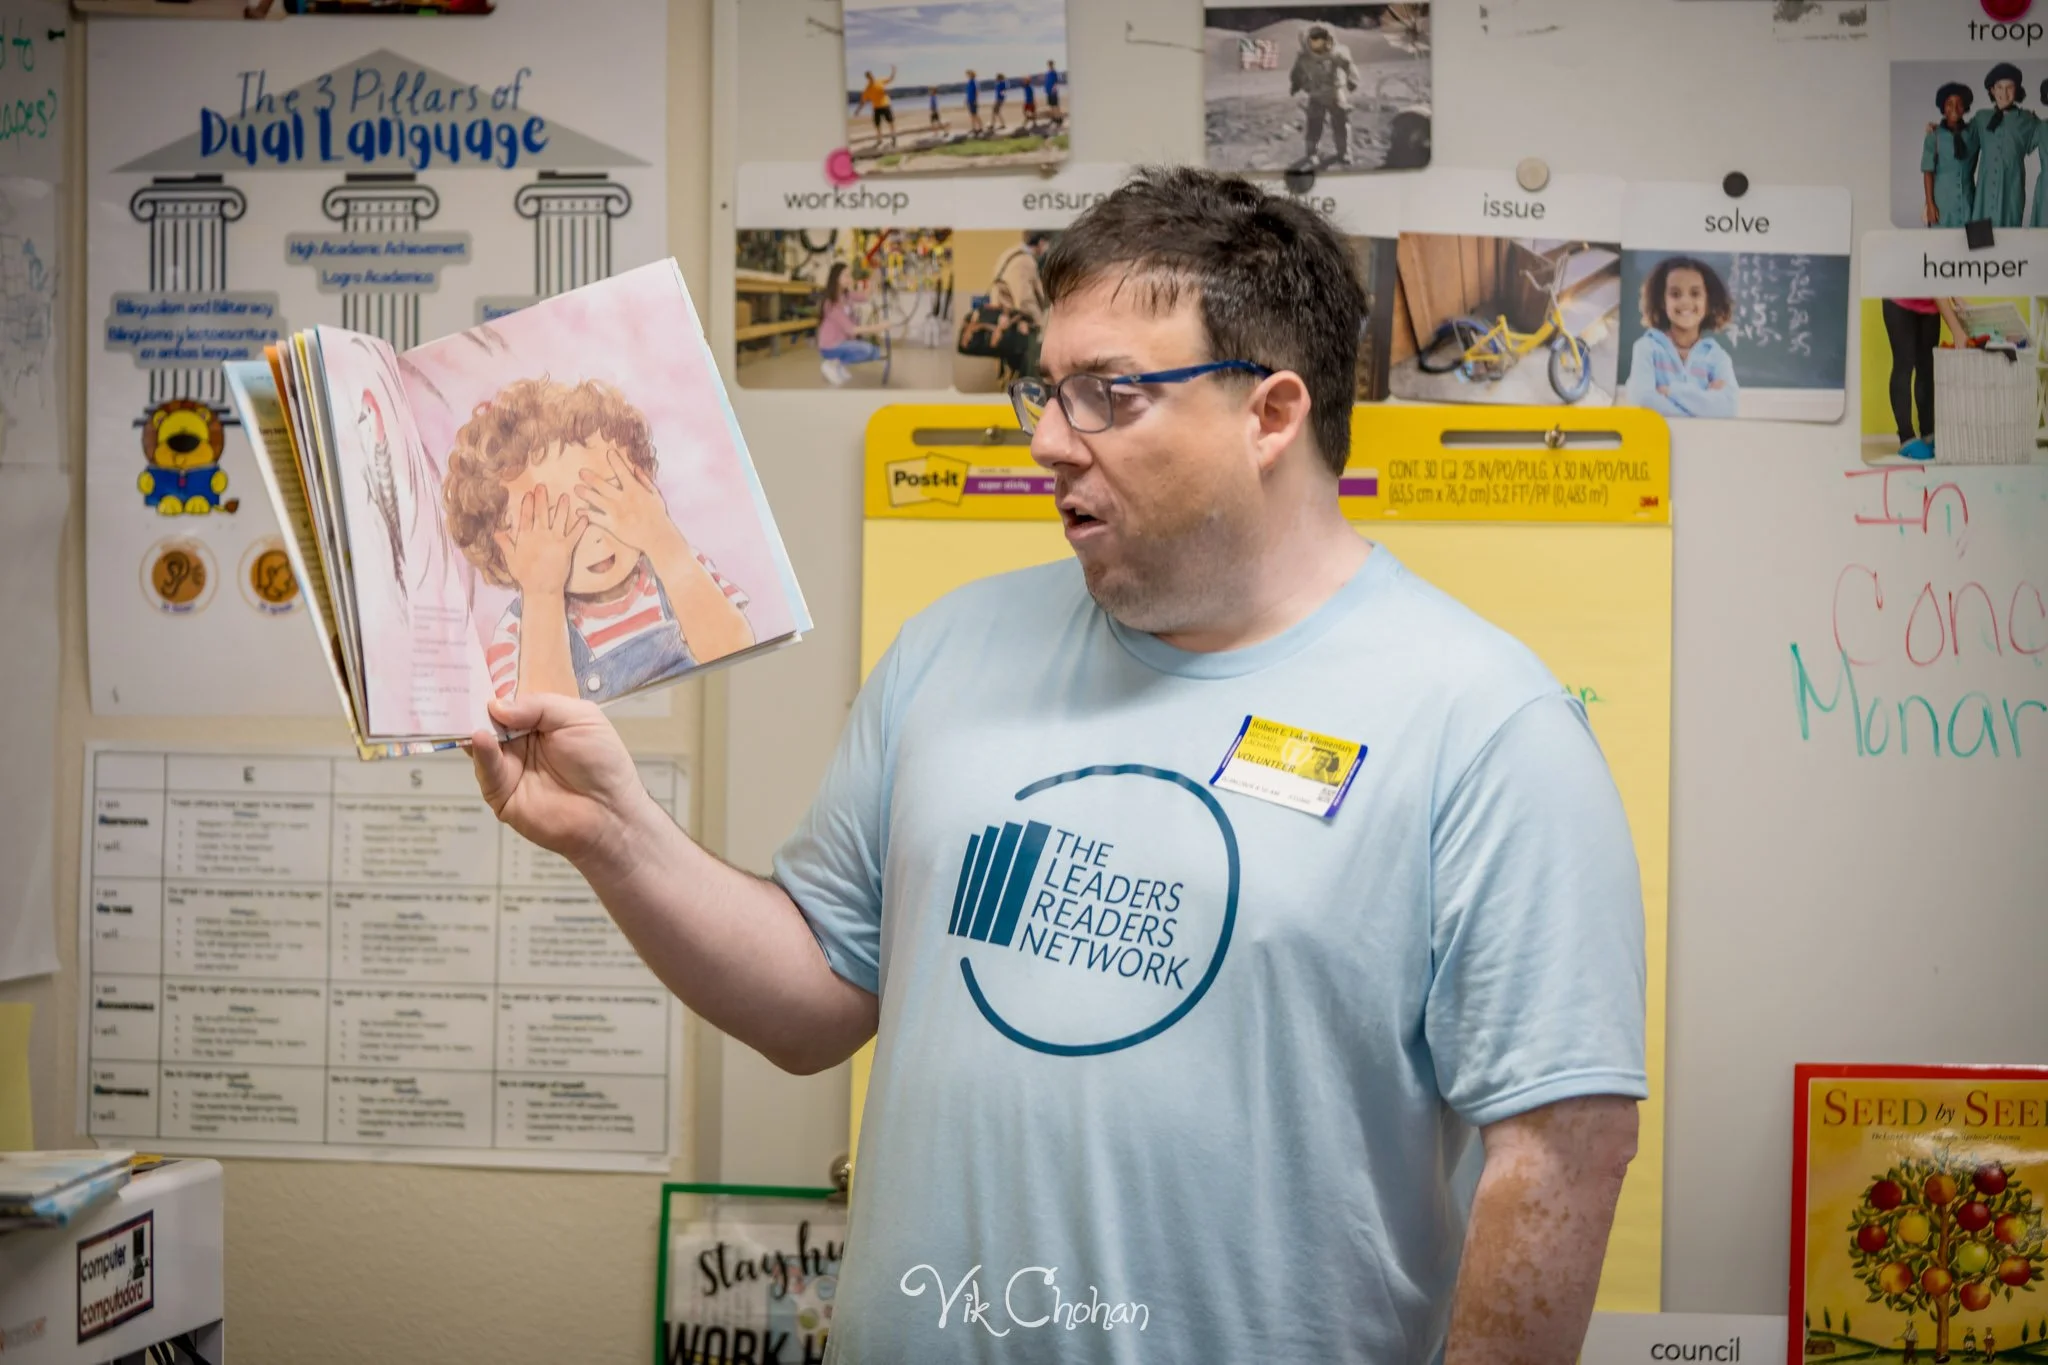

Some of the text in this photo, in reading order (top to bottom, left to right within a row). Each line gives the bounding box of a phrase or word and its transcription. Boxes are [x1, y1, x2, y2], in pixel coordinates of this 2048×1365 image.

[1968, 20, 2043, 47] troop
[237, 67, 533, 120] The 3 Pillars of
[200, 106, 550, 170] Dual Language
[783, 186, 909, 214] workshop
[1482, 193, 1546, 220] issue
[1704, 208, 1770, 234] solve
[1922, 253, 2029, 280] hamper
[894, 469, 959, 487] Post-it
[1844, 465, 1969, 534] In
[1252, 720, 1279, 736] Robert
[1289, 731, 1309, 742] Lake
[1310, 735, 1353, 755] Elementary
[1237, 750, 1297, 773] VOLUNTEER
[1055, 829, 1114, 868] THE
[1043, 857, 1184, 914] LEADERS
[1031, 890, 1178, 949] READERS
[1018, 923, 1190, 990] NETWORK
[1823, 1089, 2048, 1128] SEED by SEE
[81, 1244, 126, 1283] computer
[81, 1279, 144, 1327] computadora
[1651, 1337, 1740, 1362] council
